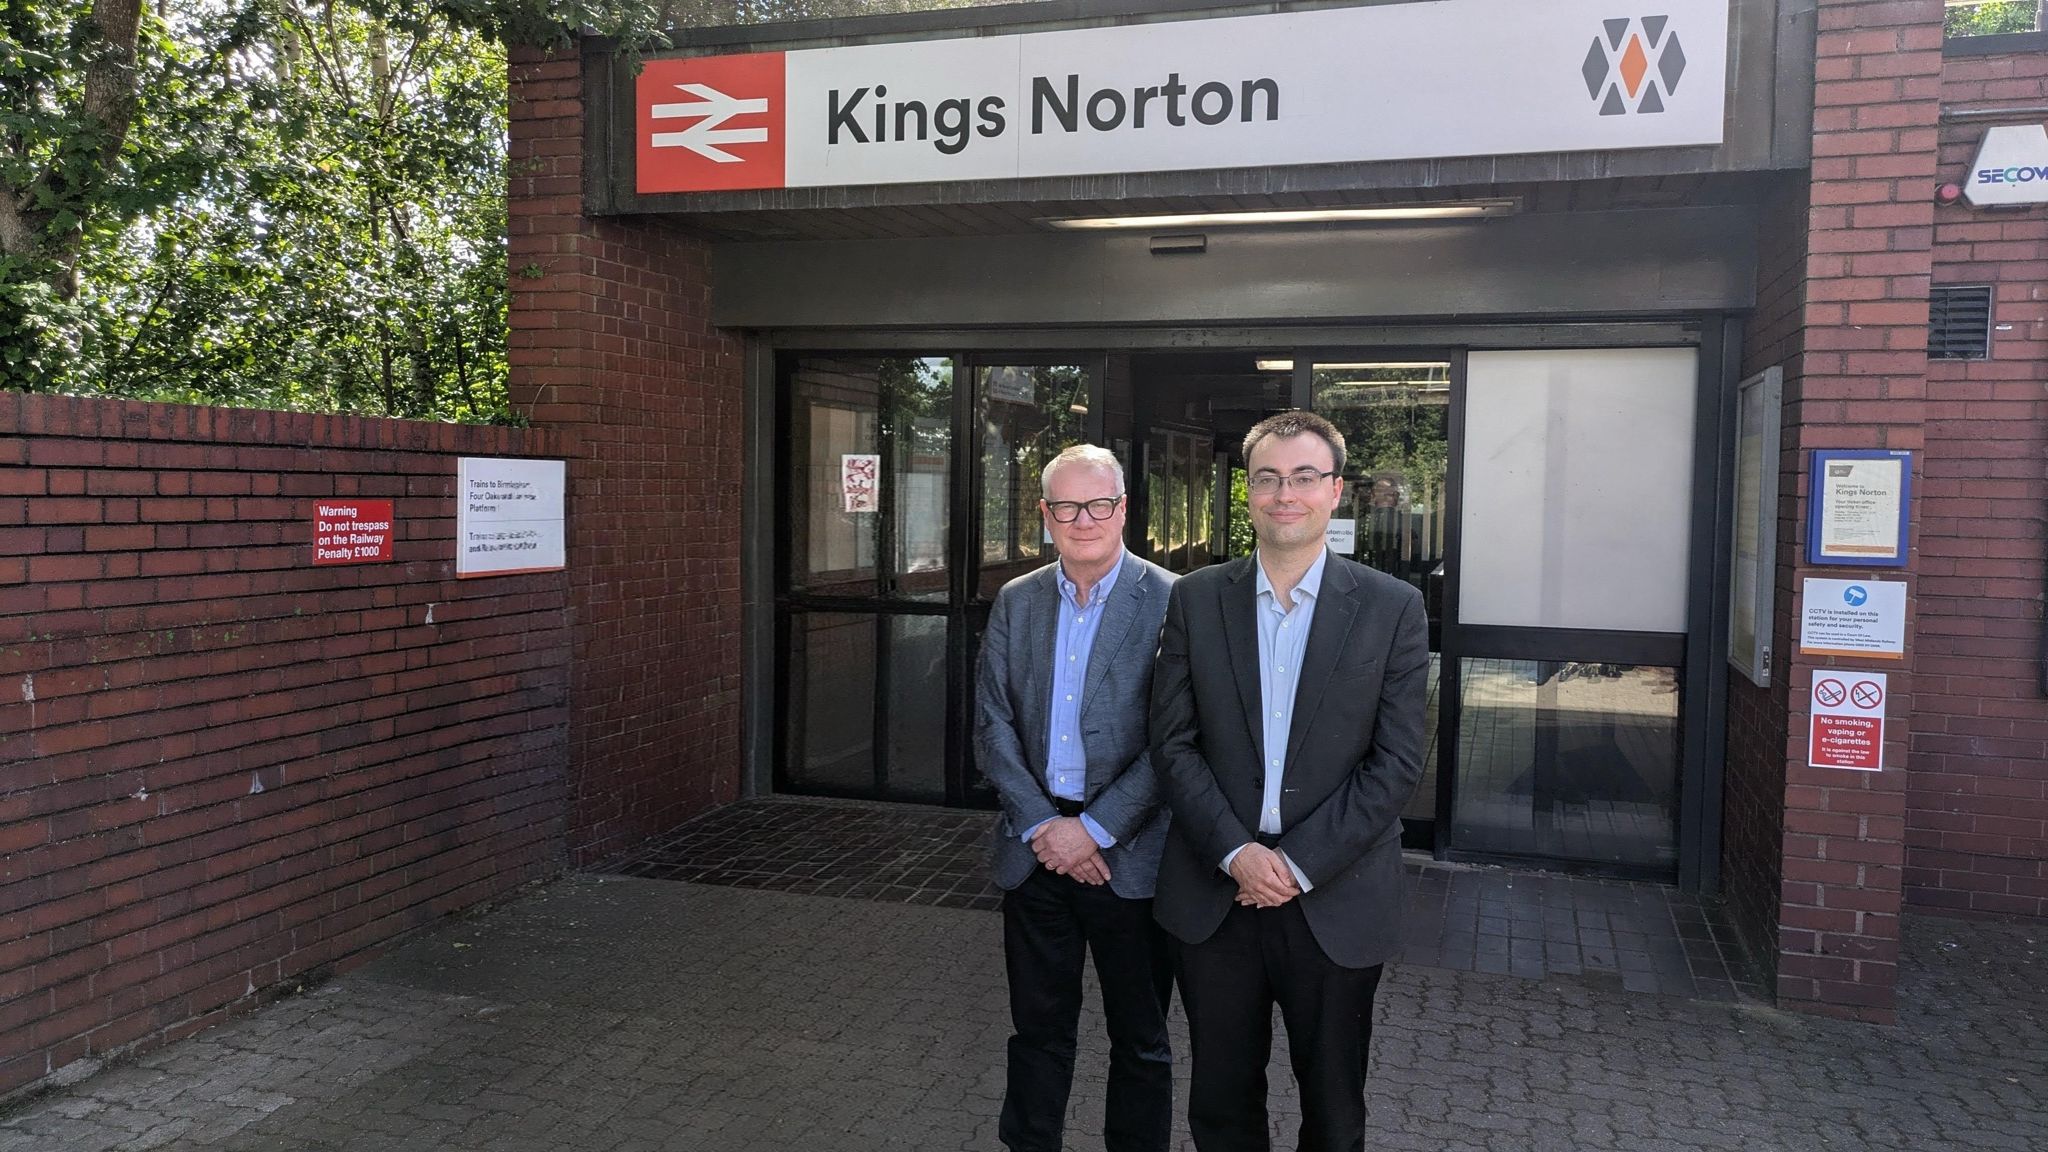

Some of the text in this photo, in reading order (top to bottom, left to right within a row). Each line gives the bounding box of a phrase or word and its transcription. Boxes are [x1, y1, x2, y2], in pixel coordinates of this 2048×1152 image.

[828, 73, 1279, 155] Kings Norton
[470, 480, 488, 488] Trains
[470, 492, 484, 500] Four
[485, 492, 500, 500] Oak
[319, 505, 357, 518] Warning
[470, 504, 496, 512] Platform
[319, 520, 389, 532] Do not trespass
[318, 533, 384, 545] on the Railway
[318, 546, 380, 560] Penalty £1000
[1834, 718, 1874, 728] smoking,
[1828, 728, 1855, 736] vaping
[1822, 737, 1871, 746] e-cigarettes
